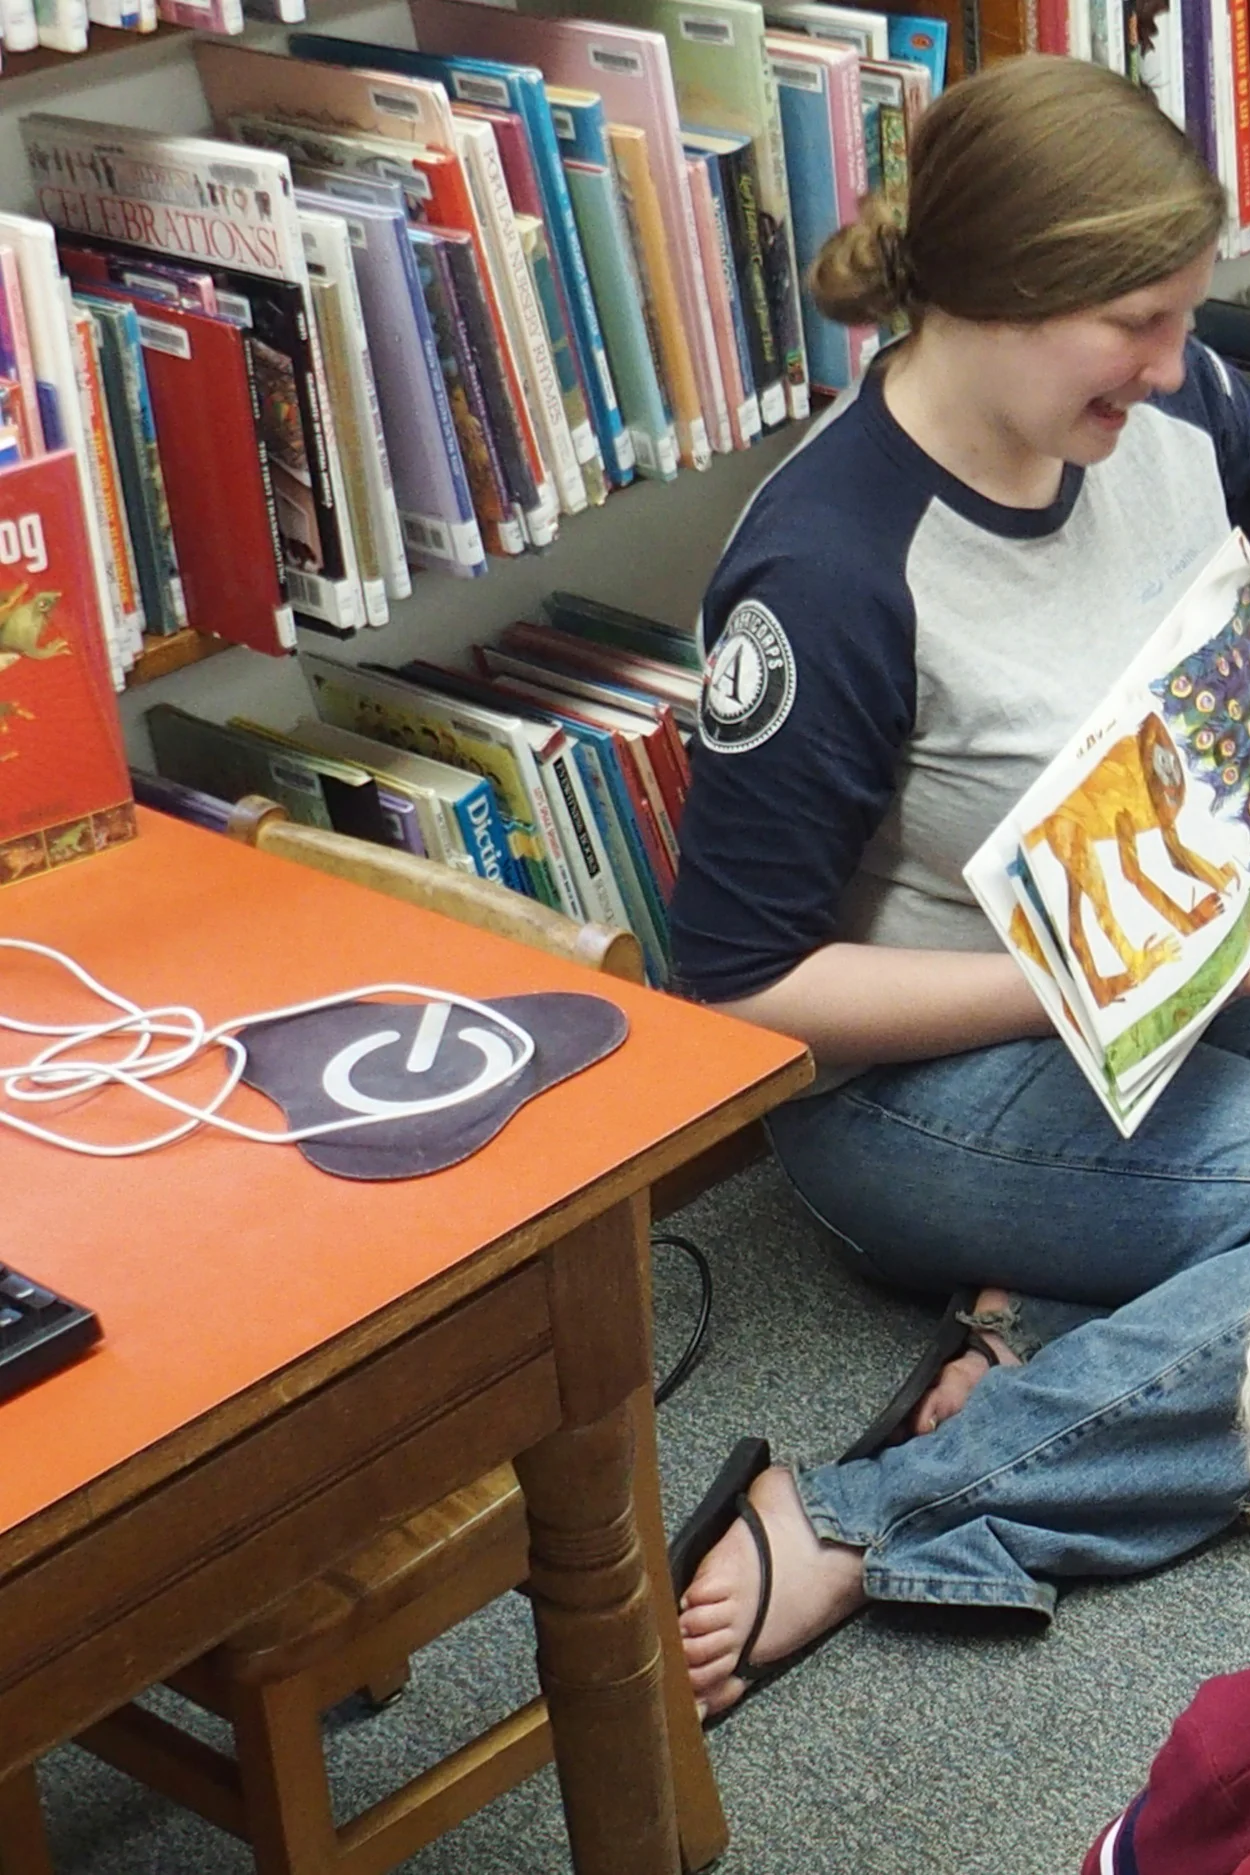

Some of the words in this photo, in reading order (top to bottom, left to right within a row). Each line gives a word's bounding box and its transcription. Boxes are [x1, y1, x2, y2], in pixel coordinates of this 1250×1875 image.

[39, 188, 284, 271] CELEBRATIONS!
[484, 149, 516, 243] POPULAR
[510, 247, 543, 339] NURSERY
[533, 345, 562, 427] RHYMES
[712, 643, 744, 705] A
[729, 612, 784, 671] ERICORPS
[466, 796, 504, 886] Dictio
